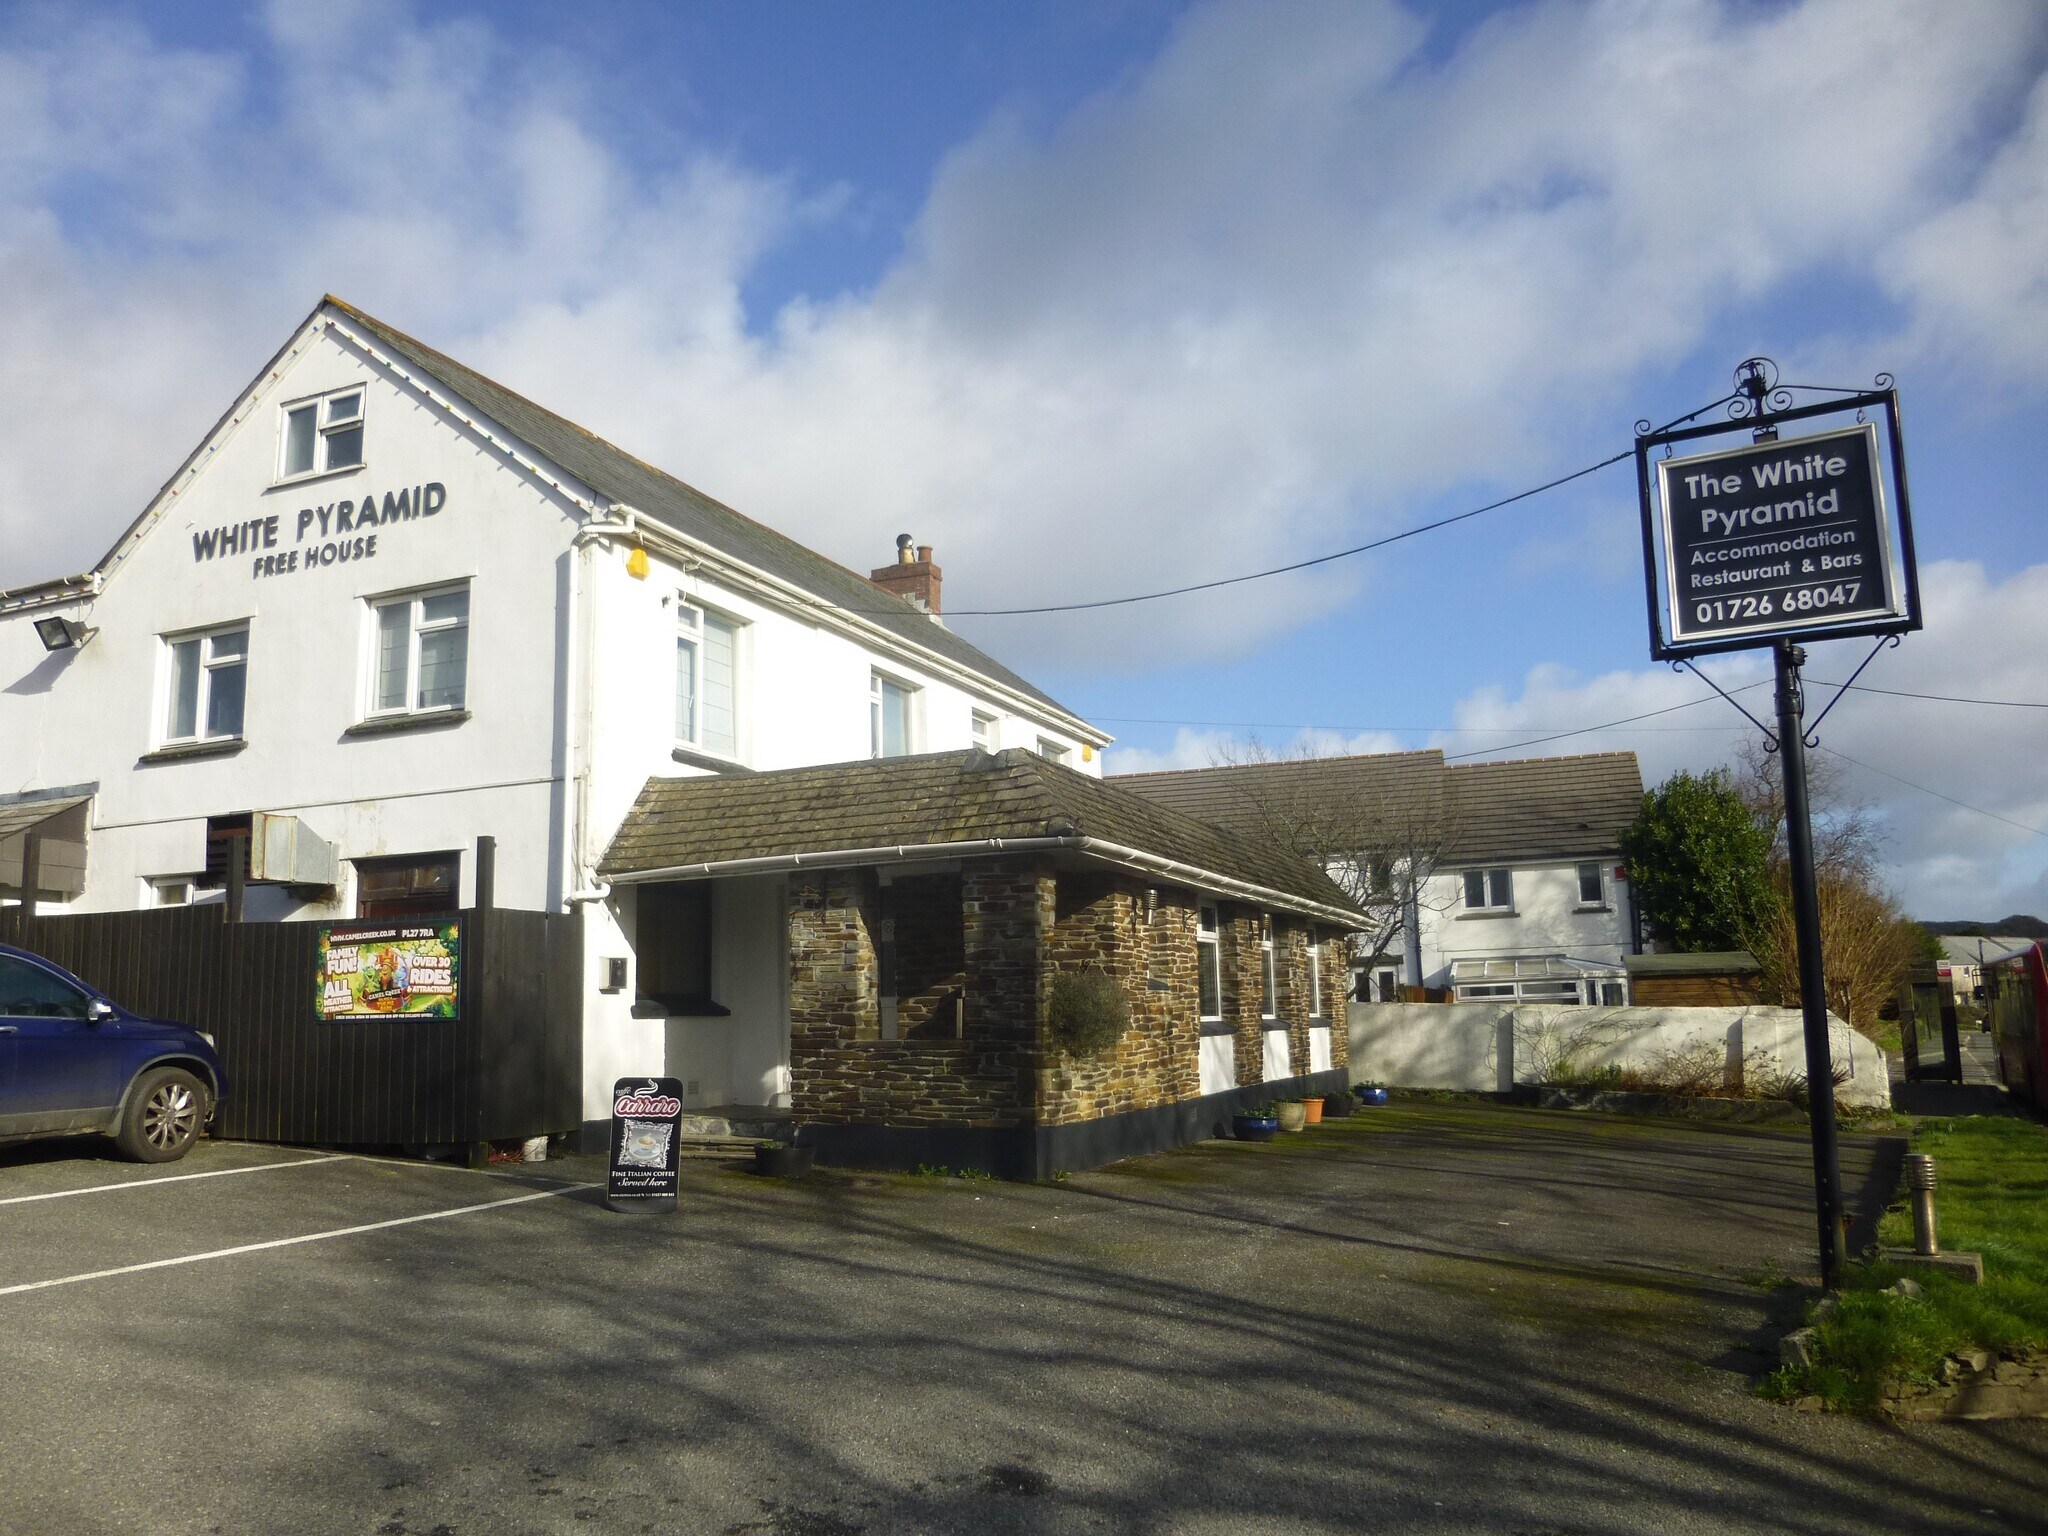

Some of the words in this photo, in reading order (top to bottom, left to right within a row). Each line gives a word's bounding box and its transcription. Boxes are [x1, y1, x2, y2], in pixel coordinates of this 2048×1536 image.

[1685, 474, 1742, 499] The
[1752, 455, 1847, 488] White
[193, 515, 280, 563] WHITE
[296, 482, 447, 543] PYRAMID
[1701, 488, 1839, 535] Pyramid
[253, 550, 299, 580] FREE
[304, 534, 378, 570] HOUSE
[1690, 530, 1855, 565] Accommodation
[1690, 561, 1791, 588] Restaurant
[1801, 558, 1815, 573] &
[1820, 553, 1862, 570] Bars
[1696, 595, 1773, 623] 01726
[1782, 583, 1861, 612] 68047
[402, 929, 418, 938] PL27
[419, 928, 434, 937] 7RA
[326, 946, 359, 960] FAMILY
[327, 957, 358, 975] FUN!
[413, 956, 437, 967] OVER
[438, 956, 451, 967] 30
[323, 979, 352, 998] ALL
[409, 968, 451, 985] RIDES
[617, 1177, 650, 1187] Served
[649, 1177, 668, 1187] here
